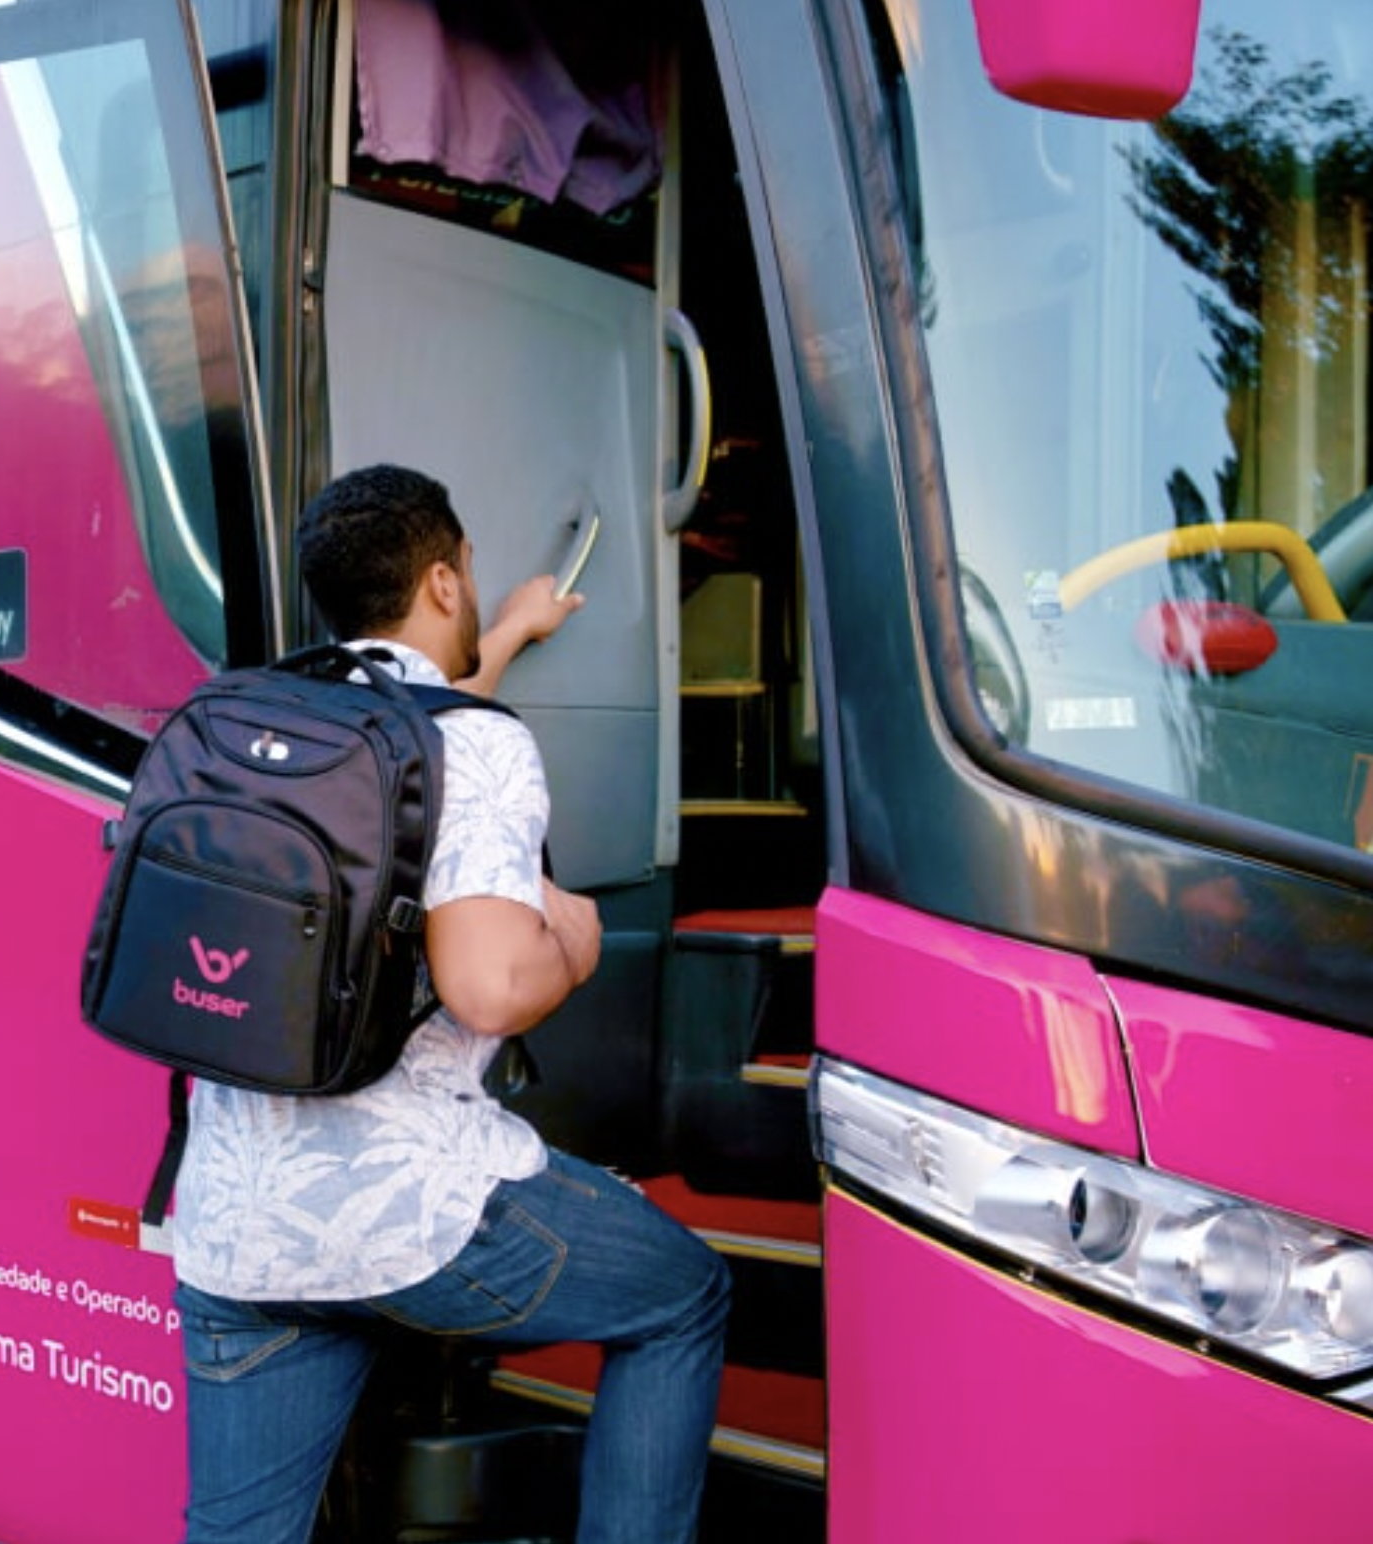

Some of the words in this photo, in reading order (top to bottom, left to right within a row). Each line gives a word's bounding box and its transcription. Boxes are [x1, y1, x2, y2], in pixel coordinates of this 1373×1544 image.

[172, 976, 250, 1019] buser
[56, 1281, 68, 1301] e
[72, 1279, 161, 1325] Operado
[41, 1338, 174, 1412] Turismo
